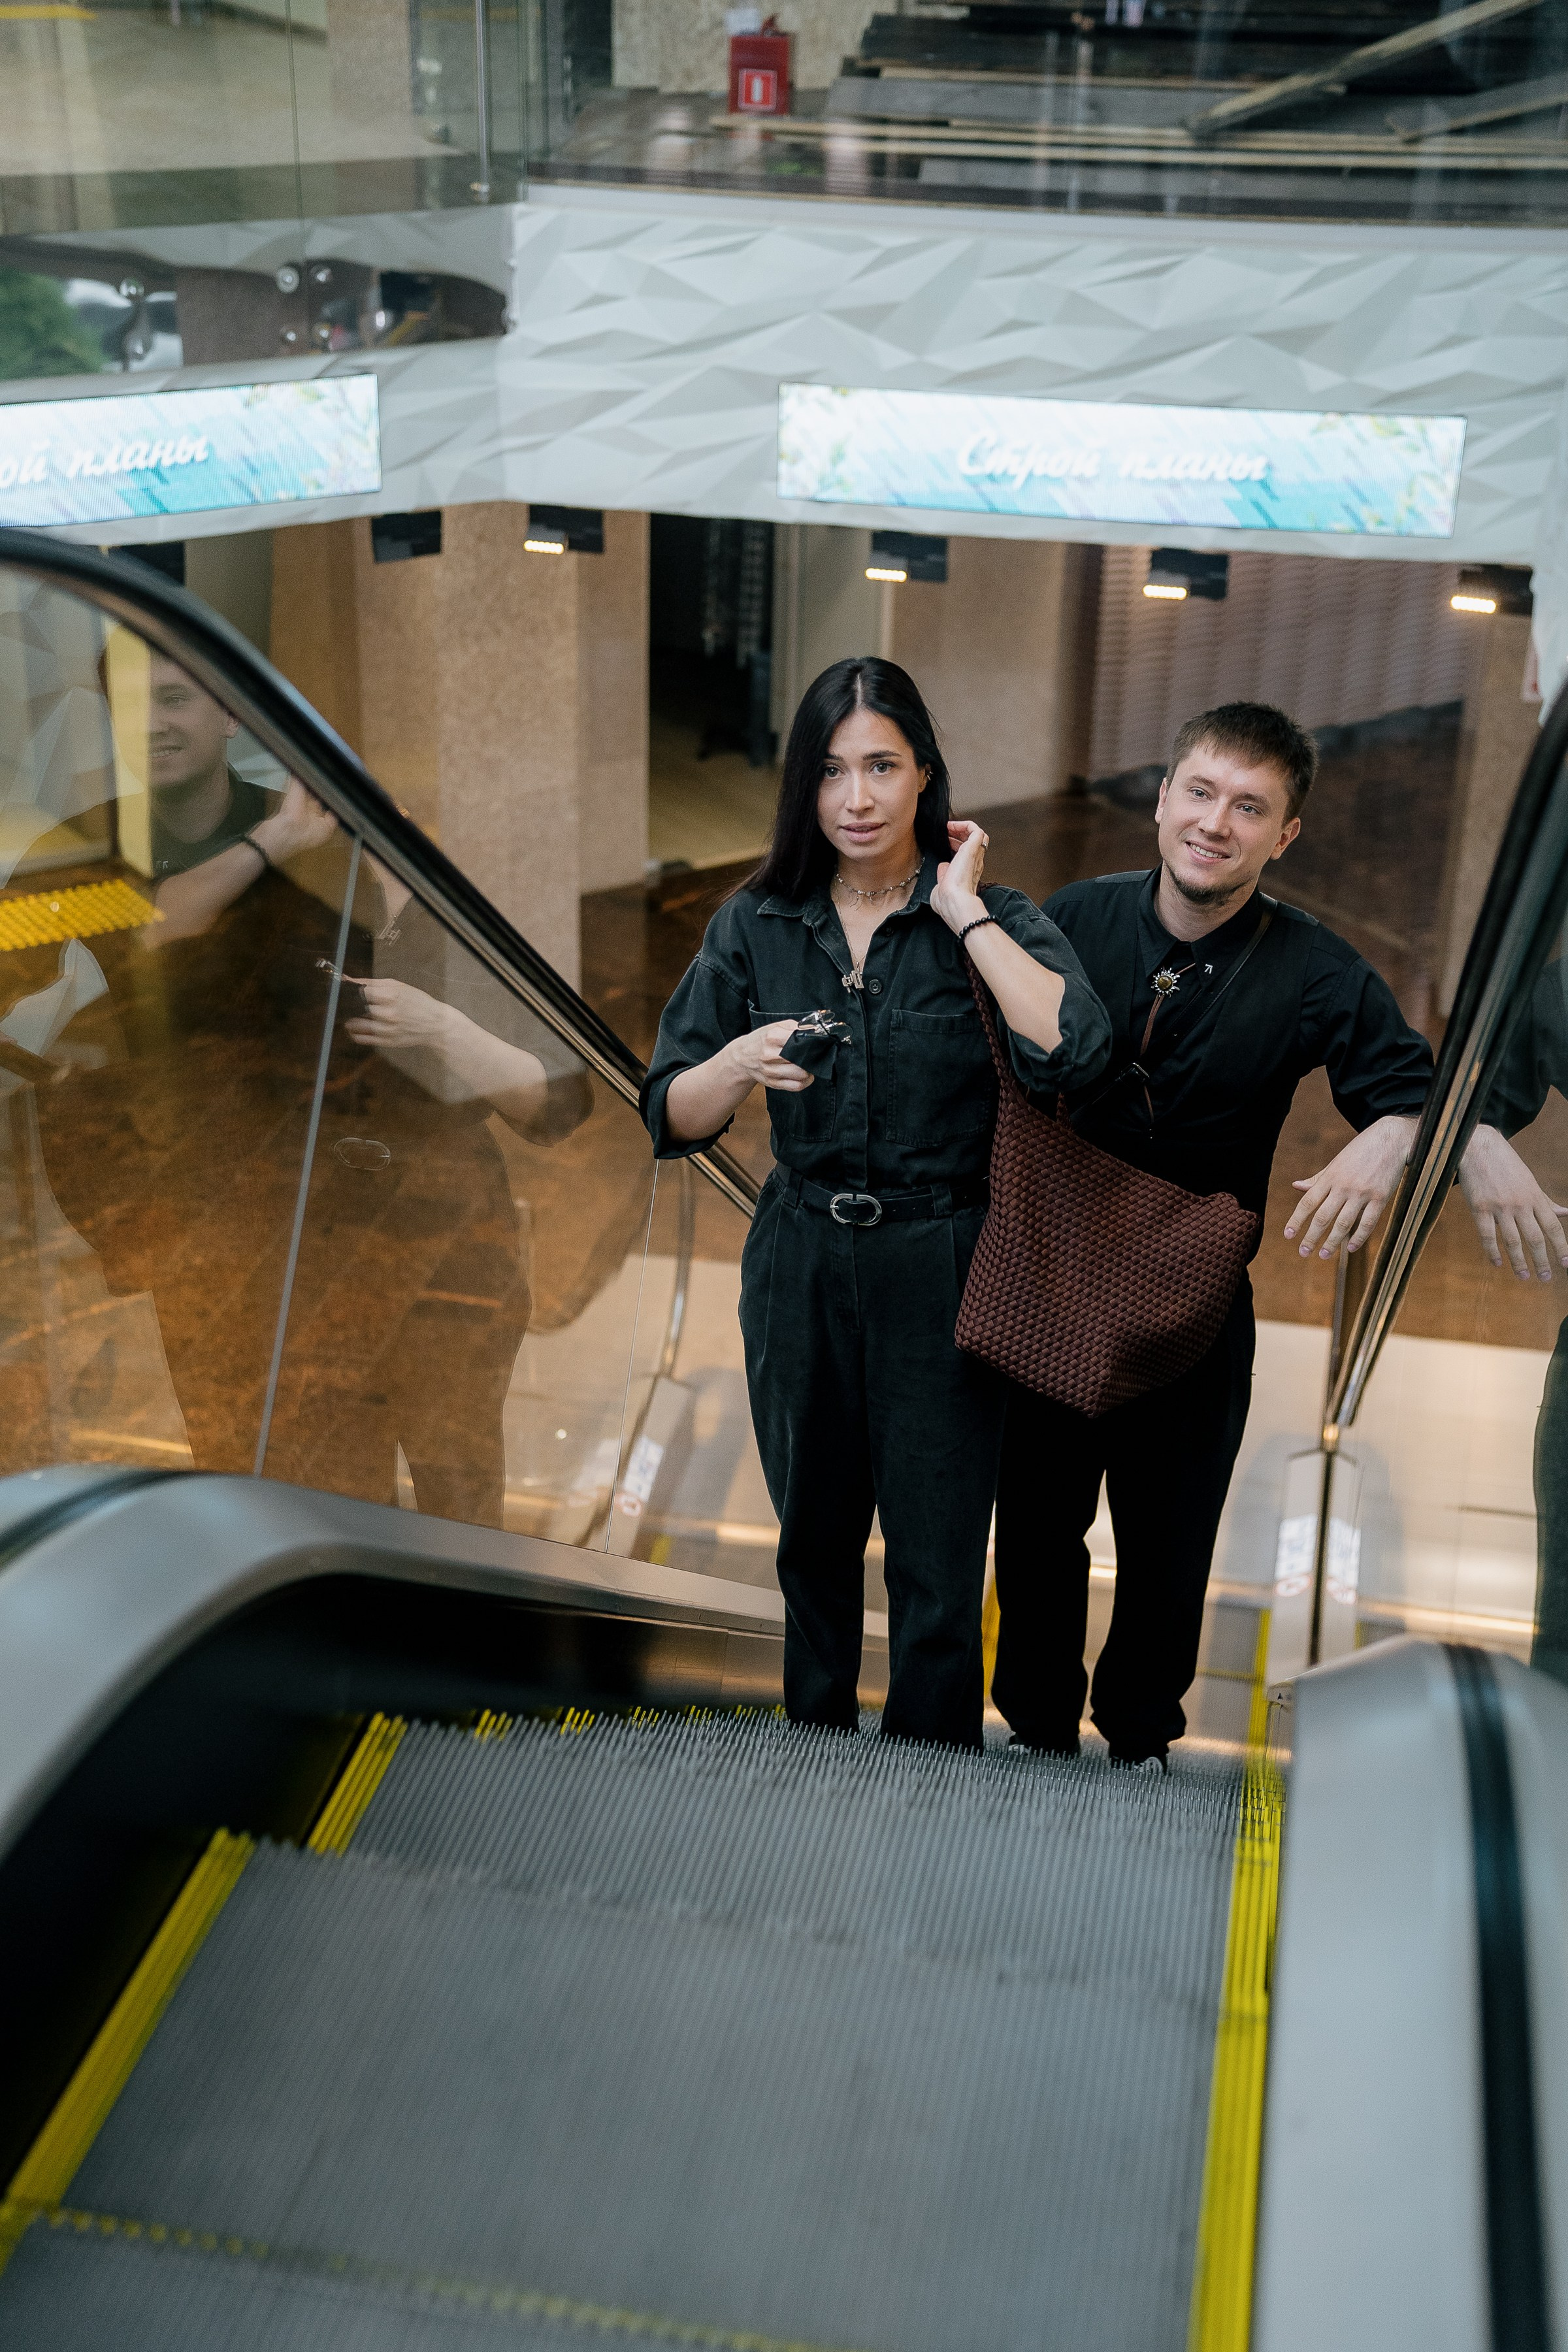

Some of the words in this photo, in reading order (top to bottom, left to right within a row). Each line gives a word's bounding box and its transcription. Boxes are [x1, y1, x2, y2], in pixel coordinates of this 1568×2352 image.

[67, 434, 208, 480] планы
[957, 429, 1103, 491] Строй
[1117, 451, 1266, 481] планы
